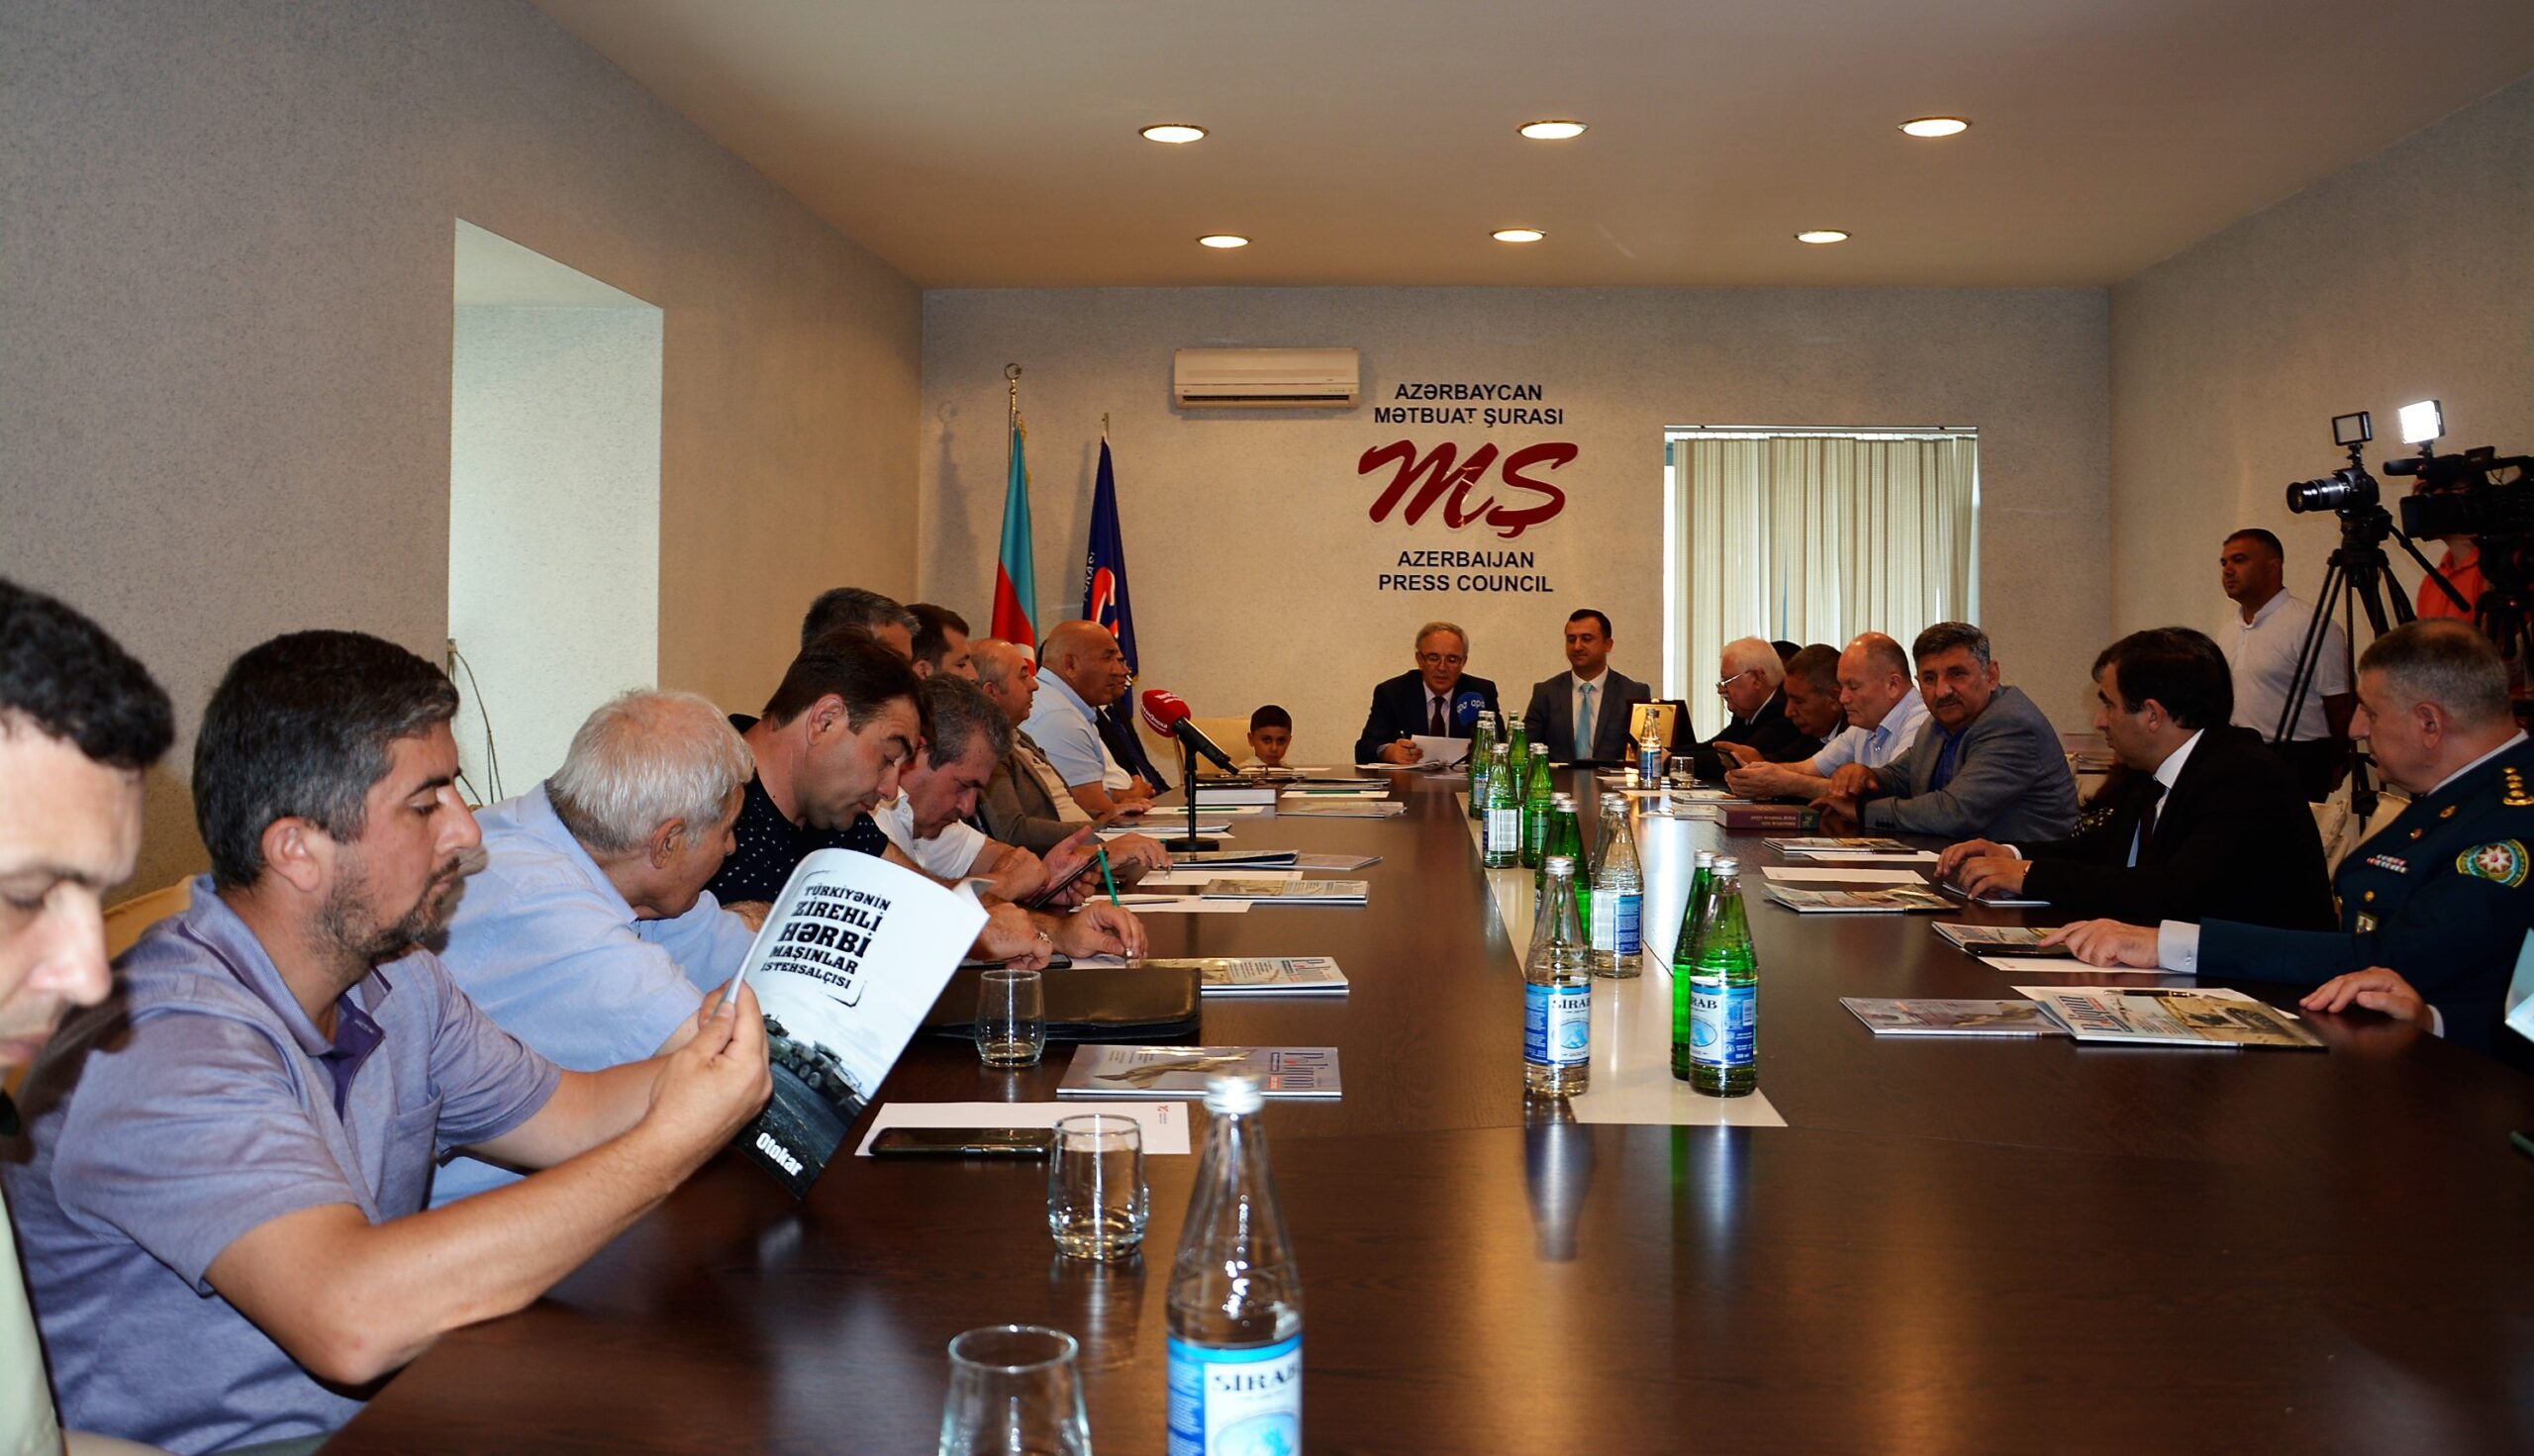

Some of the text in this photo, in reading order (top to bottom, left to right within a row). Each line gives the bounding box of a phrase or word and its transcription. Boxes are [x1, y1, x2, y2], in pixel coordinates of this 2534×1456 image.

[1395, 383, 1542, 401] AZƏRBAYCAN
[1374, 407, 1563, 428] MƏTBUAT ŞURASI
[1397, 550, 1534, 568] AZERBAIJAN
[1378, 574, 1553, 592] PRESS COUNCIL
[804, 882, 892, 911] TÜRKİYƏNİN
[790, 896, 884, 932] ZİREHLİ
[777, 922, 872, 958] HƏRBİ
[768, 944, 859, 975] MAŞINLAR
[1691, 996, 1717, 1009] RAB
[756, 1132, 804, 1176] Otokar
